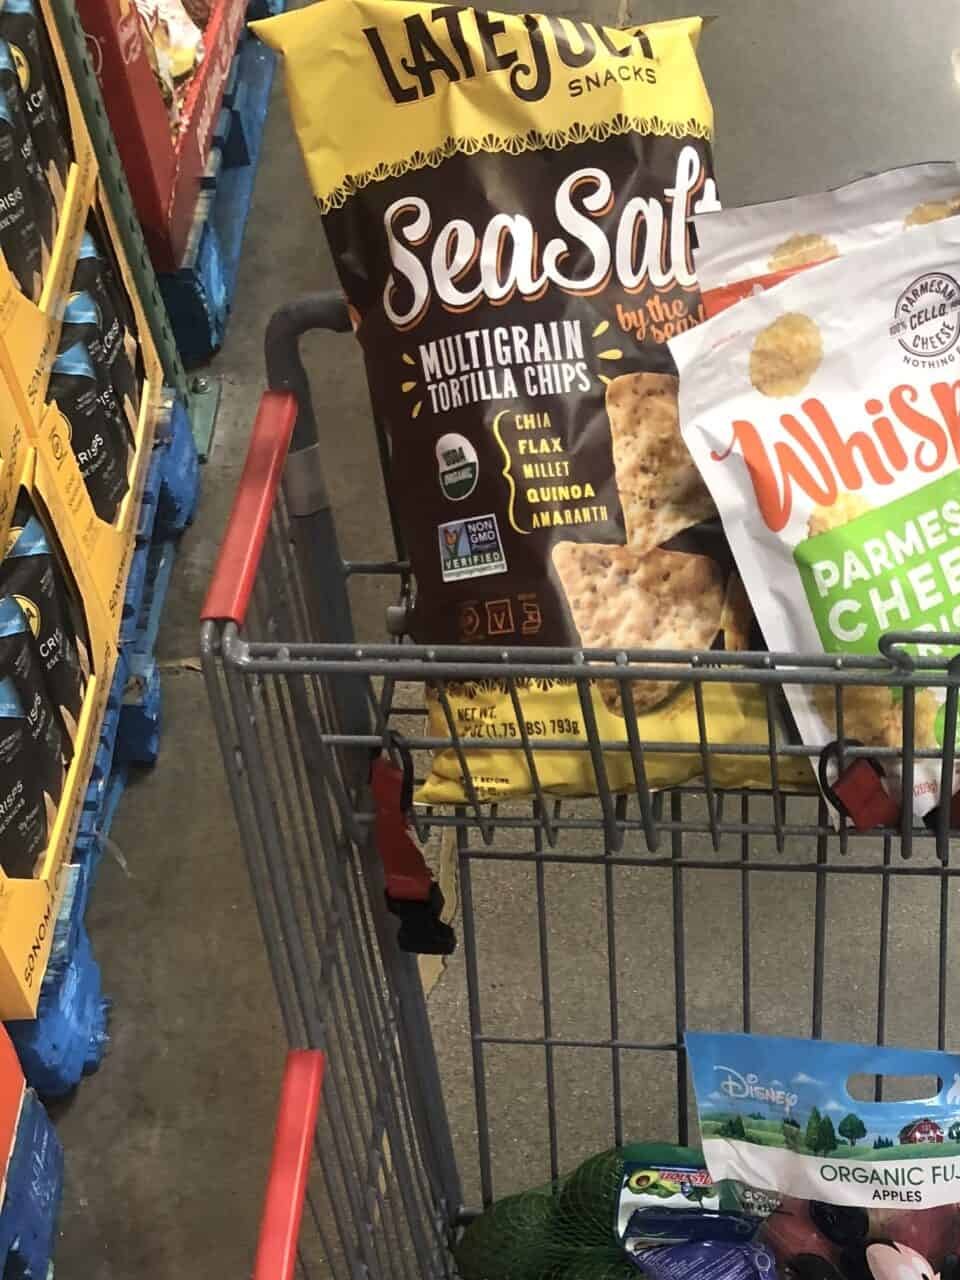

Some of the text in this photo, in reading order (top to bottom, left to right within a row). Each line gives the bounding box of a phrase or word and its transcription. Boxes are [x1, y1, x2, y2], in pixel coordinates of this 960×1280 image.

[363, 6, 520, 104] LATE
[568, 65, 658, 97] SNACKS
[383, 195, 546, 330] Sea
[912, 320, 955, 350] CHEESE
[418, 319, 585, 383] MULTIGRAIN
[428, 362, 592, 414] TORTILLA CHIPS
[515, 413, 552, 431] CHIA
[518, 437, 564, 455] FLAX
[523, 461, 570, 479] MILLET
[526, 484, 596, 503] QUINOA
[467, 520, 494, 534] NON
[531, 506, 609, 529] AMARANTH
[470, 530, 497, 545] GMO
[445, 551, 502, 569] VERIFIED
[819, 1162, 926, 1187] ORGANIC
[871, 1187, 923, 1203] APPLES
